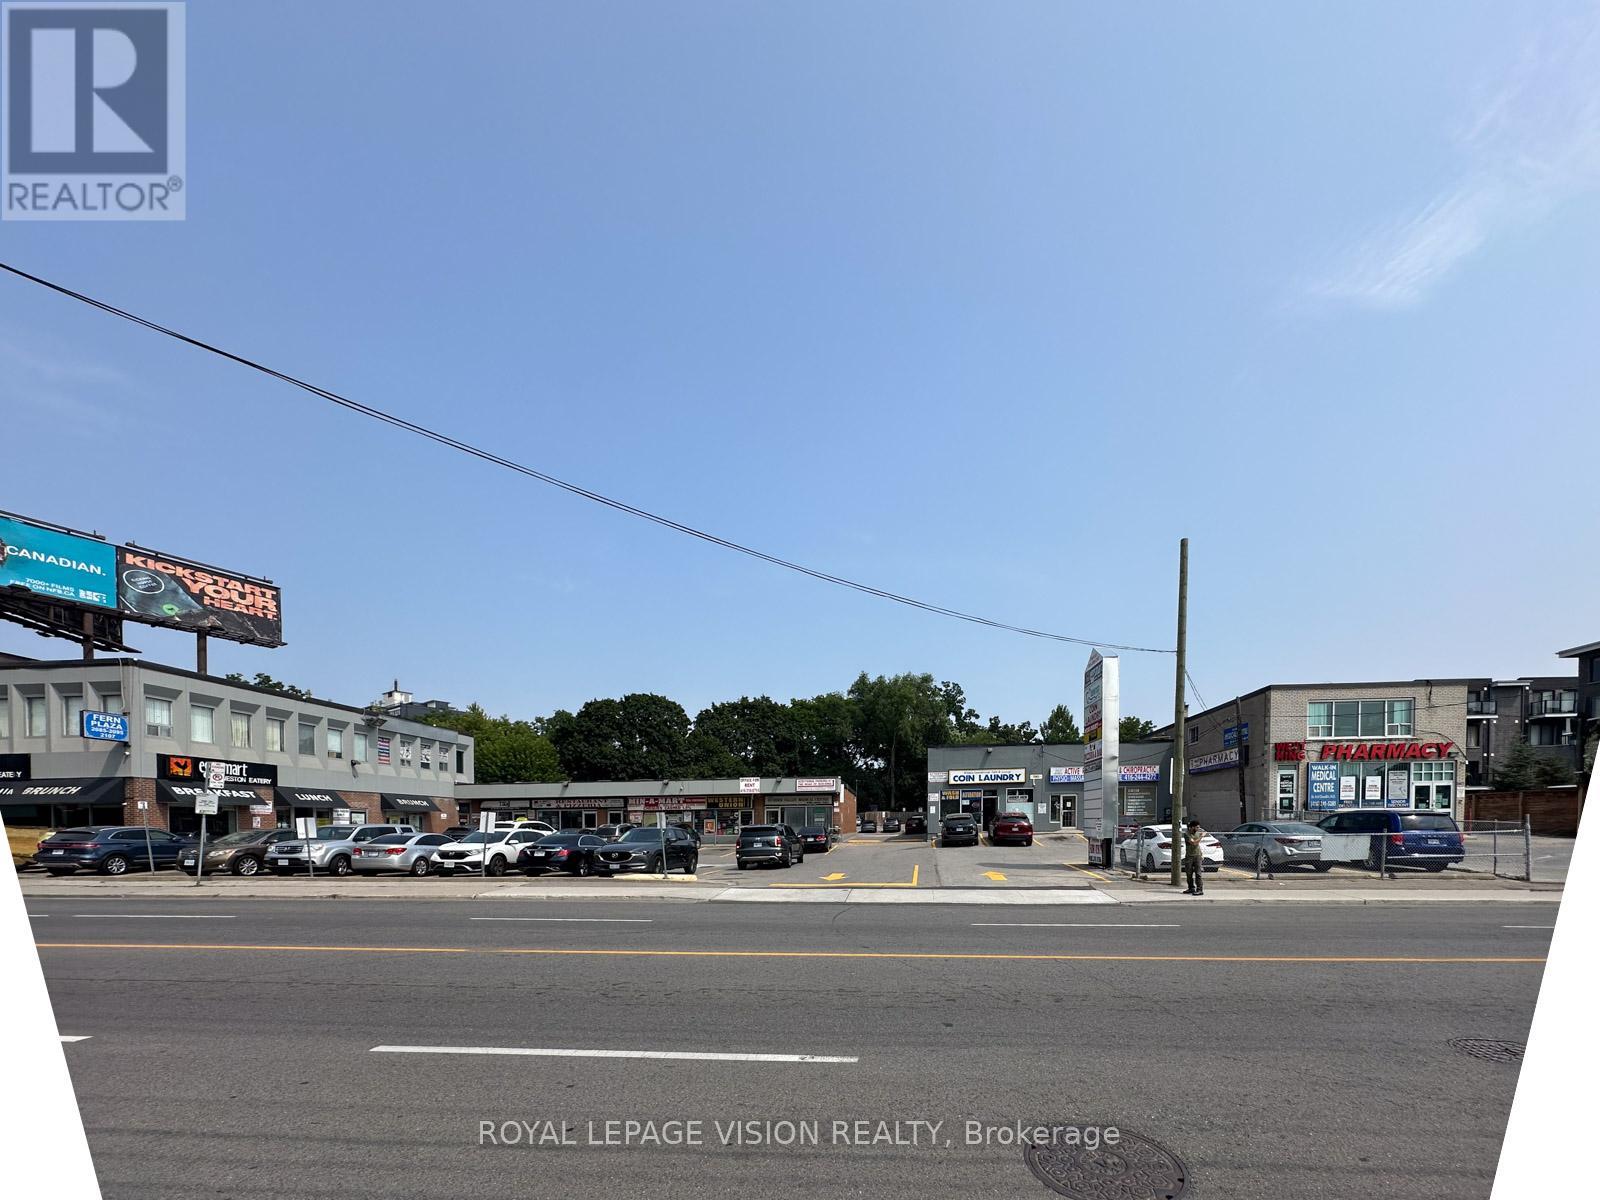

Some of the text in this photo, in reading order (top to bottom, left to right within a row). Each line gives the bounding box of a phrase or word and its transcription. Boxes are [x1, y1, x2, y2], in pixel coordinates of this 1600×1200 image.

[6, 545, 107, 577] CANADIAN.
[125, 553, 277, 600] KICKSTART
[25, 577, 75, 592] 7000+ FILMS
[186, 577, 278, 614] YOUR
[203, 595, 278, 621] HEART
[90, 720, 123, 731] PLAZA
[93, 713, 121, 729] FERN
[1275, 751, 1305, 761] WING
[1321, 742, 1454, 761] PHARMACY
[1200, 749, 1239, 767] PHARMACY
[1064, 767, 1080, 775] ACTIVE
[1124, 766, 1156, 774] CHIROPRACTIC
[1311, 770, 1337, 781] MEDICAL
[248, 777, 272, 785] EATERY
[978, 773, 1021, 781] LAUNDRY
[21, 786, 82, 795] BRUNCH
[171, 786, 257, 799] BREAKFAST
[1312, 782, 1335, 793] CENTRE
[294, 793, 333, 802] LUNCH
[395, 798, 430, 807] BRUNCH
